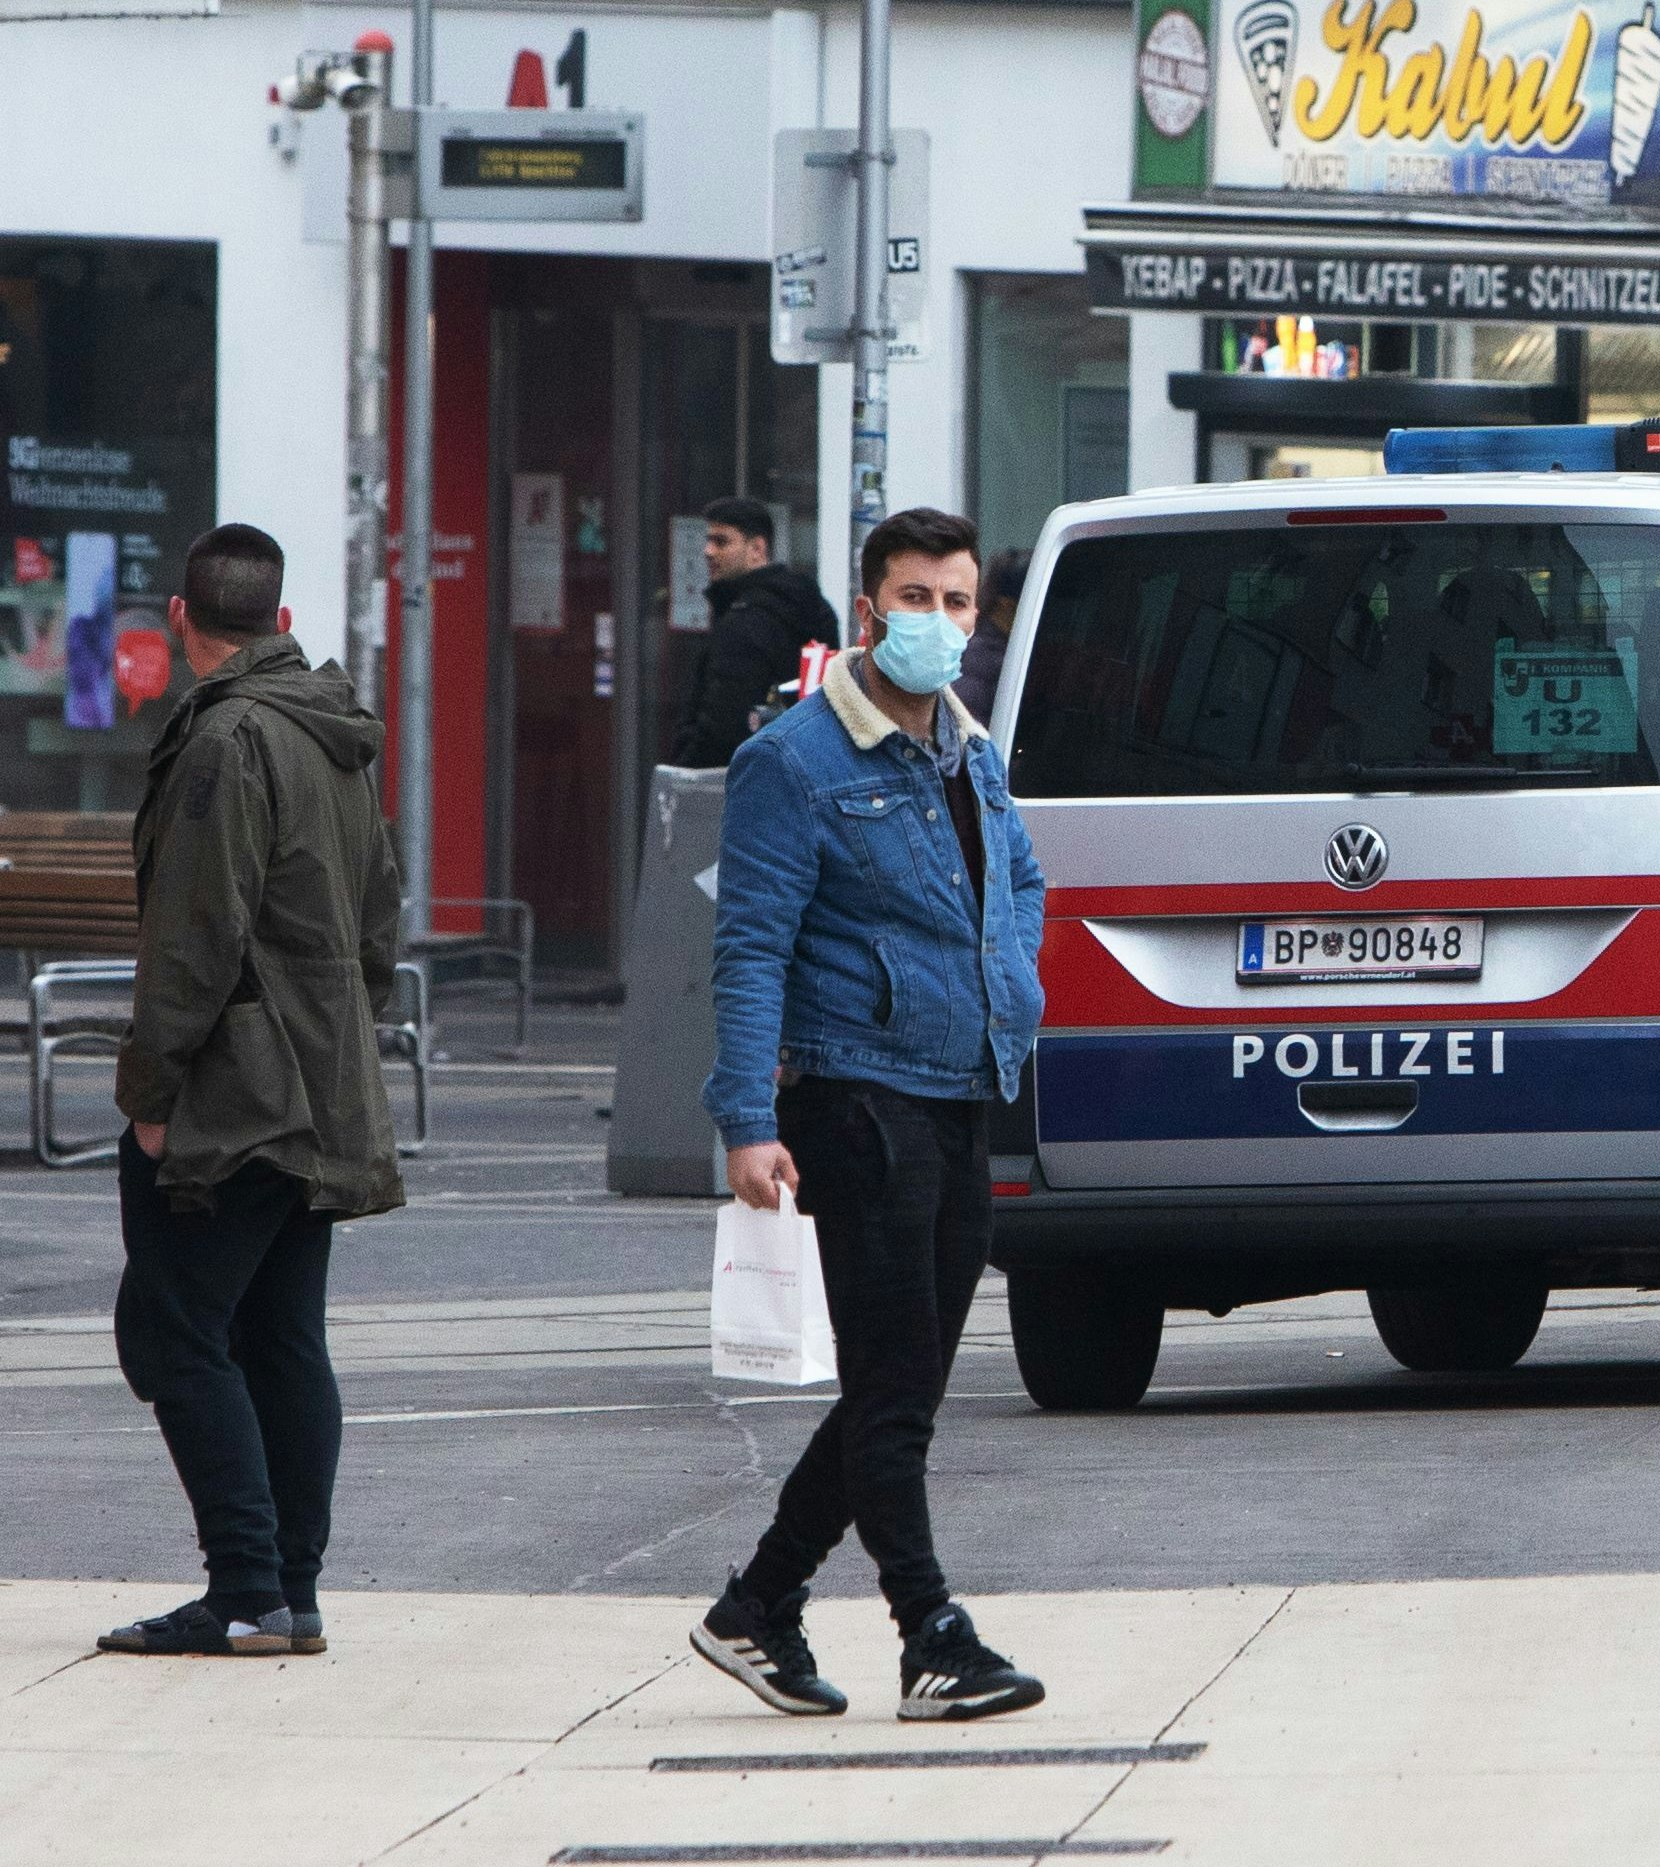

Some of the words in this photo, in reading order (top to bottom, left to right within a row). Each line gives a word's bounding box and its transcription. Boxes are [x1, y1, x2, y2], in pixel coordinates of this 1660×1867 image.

[1294, 0, 1593, 146] Kabul
[1121, 255, 1207, 299] KEBAP
[1228, 256, 1300, 300] PIZZA
[1317, 260, 1427, 306] FALAFEL
[1449, 263, 1508, 308] PIDE
[1543, 679, 1583, 704] U
[1522, 708, 1602, 737] 132
[1248, 954, 1258, 965] A
[1274, 929, 1318, 964] BP
[1348, 926, 1462, 962] 90848
[1232, 1031, 1505, 1079] POLIZEI
